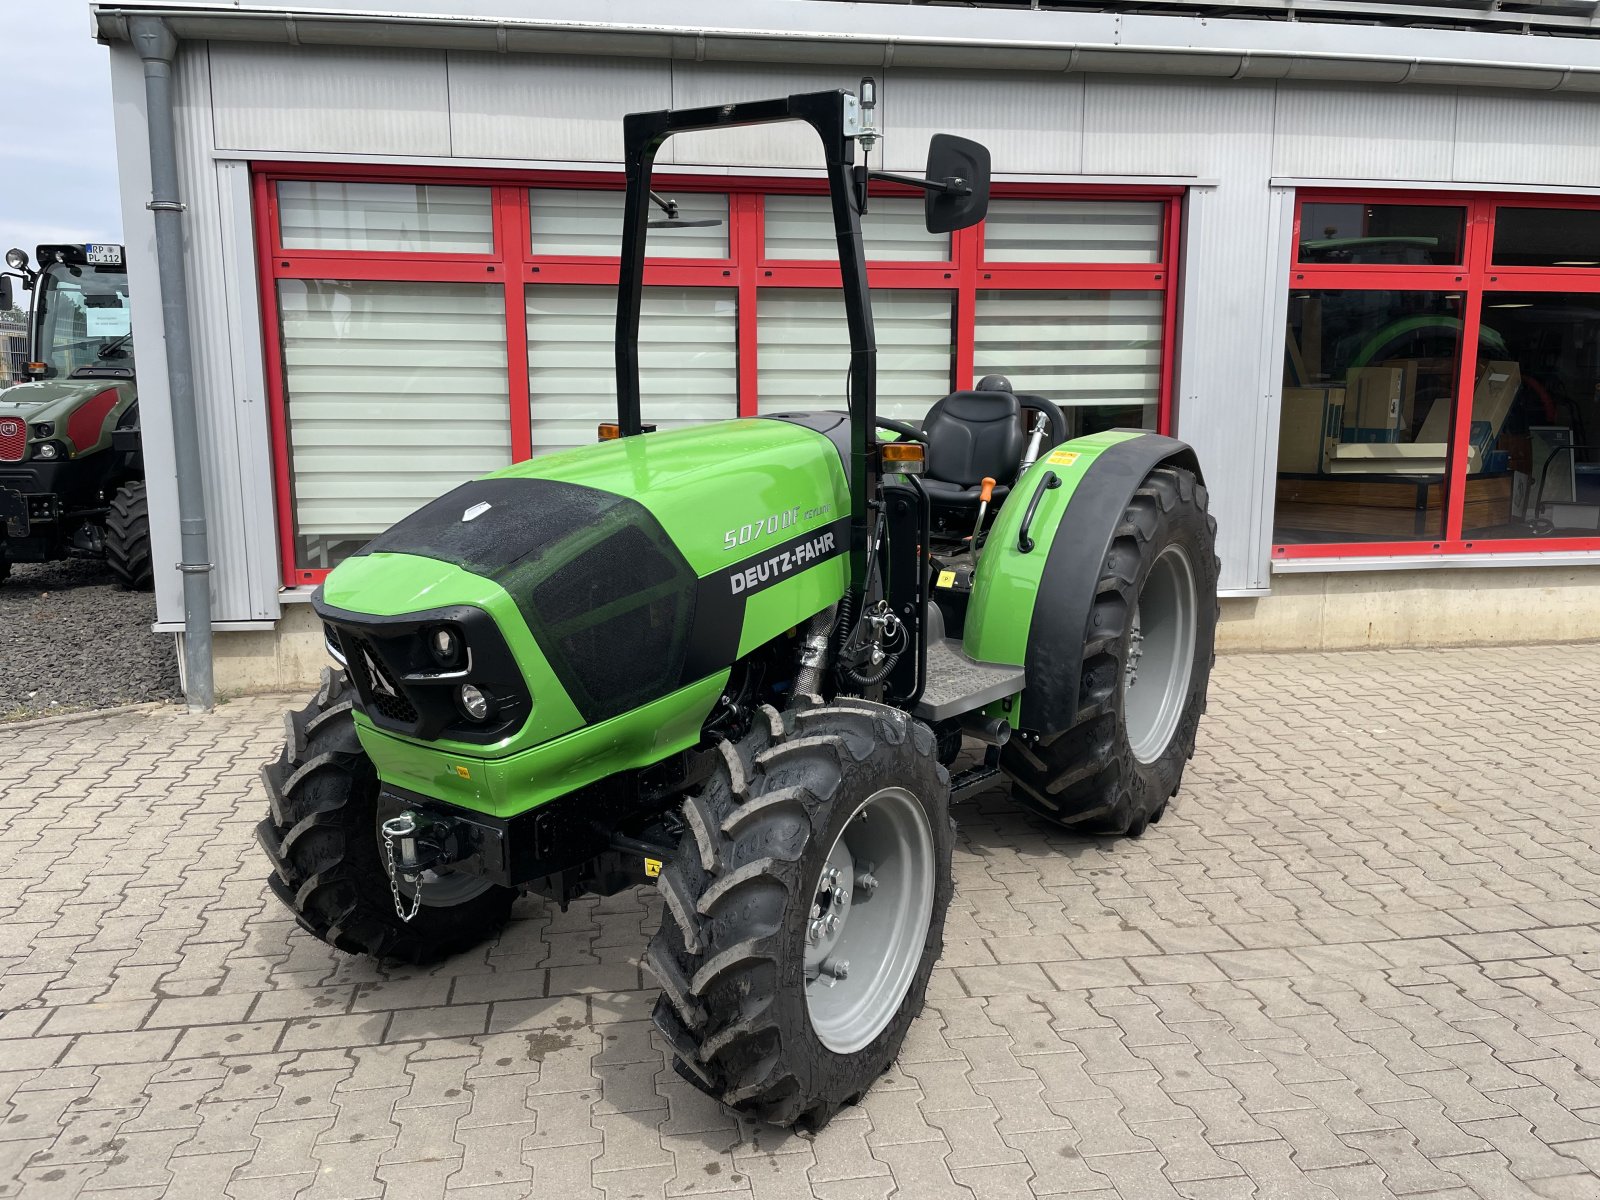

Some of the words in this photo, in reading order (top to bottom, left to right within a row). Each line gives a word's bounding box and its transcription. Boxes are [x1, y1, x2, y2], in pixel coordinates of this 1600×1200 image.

[92, 245, 104, 254] RP
[88, 254, 100, 262] PL
[103, 255, 120, 263] 112
[730, 531, 836, 595] DEUTZ-FAHR
